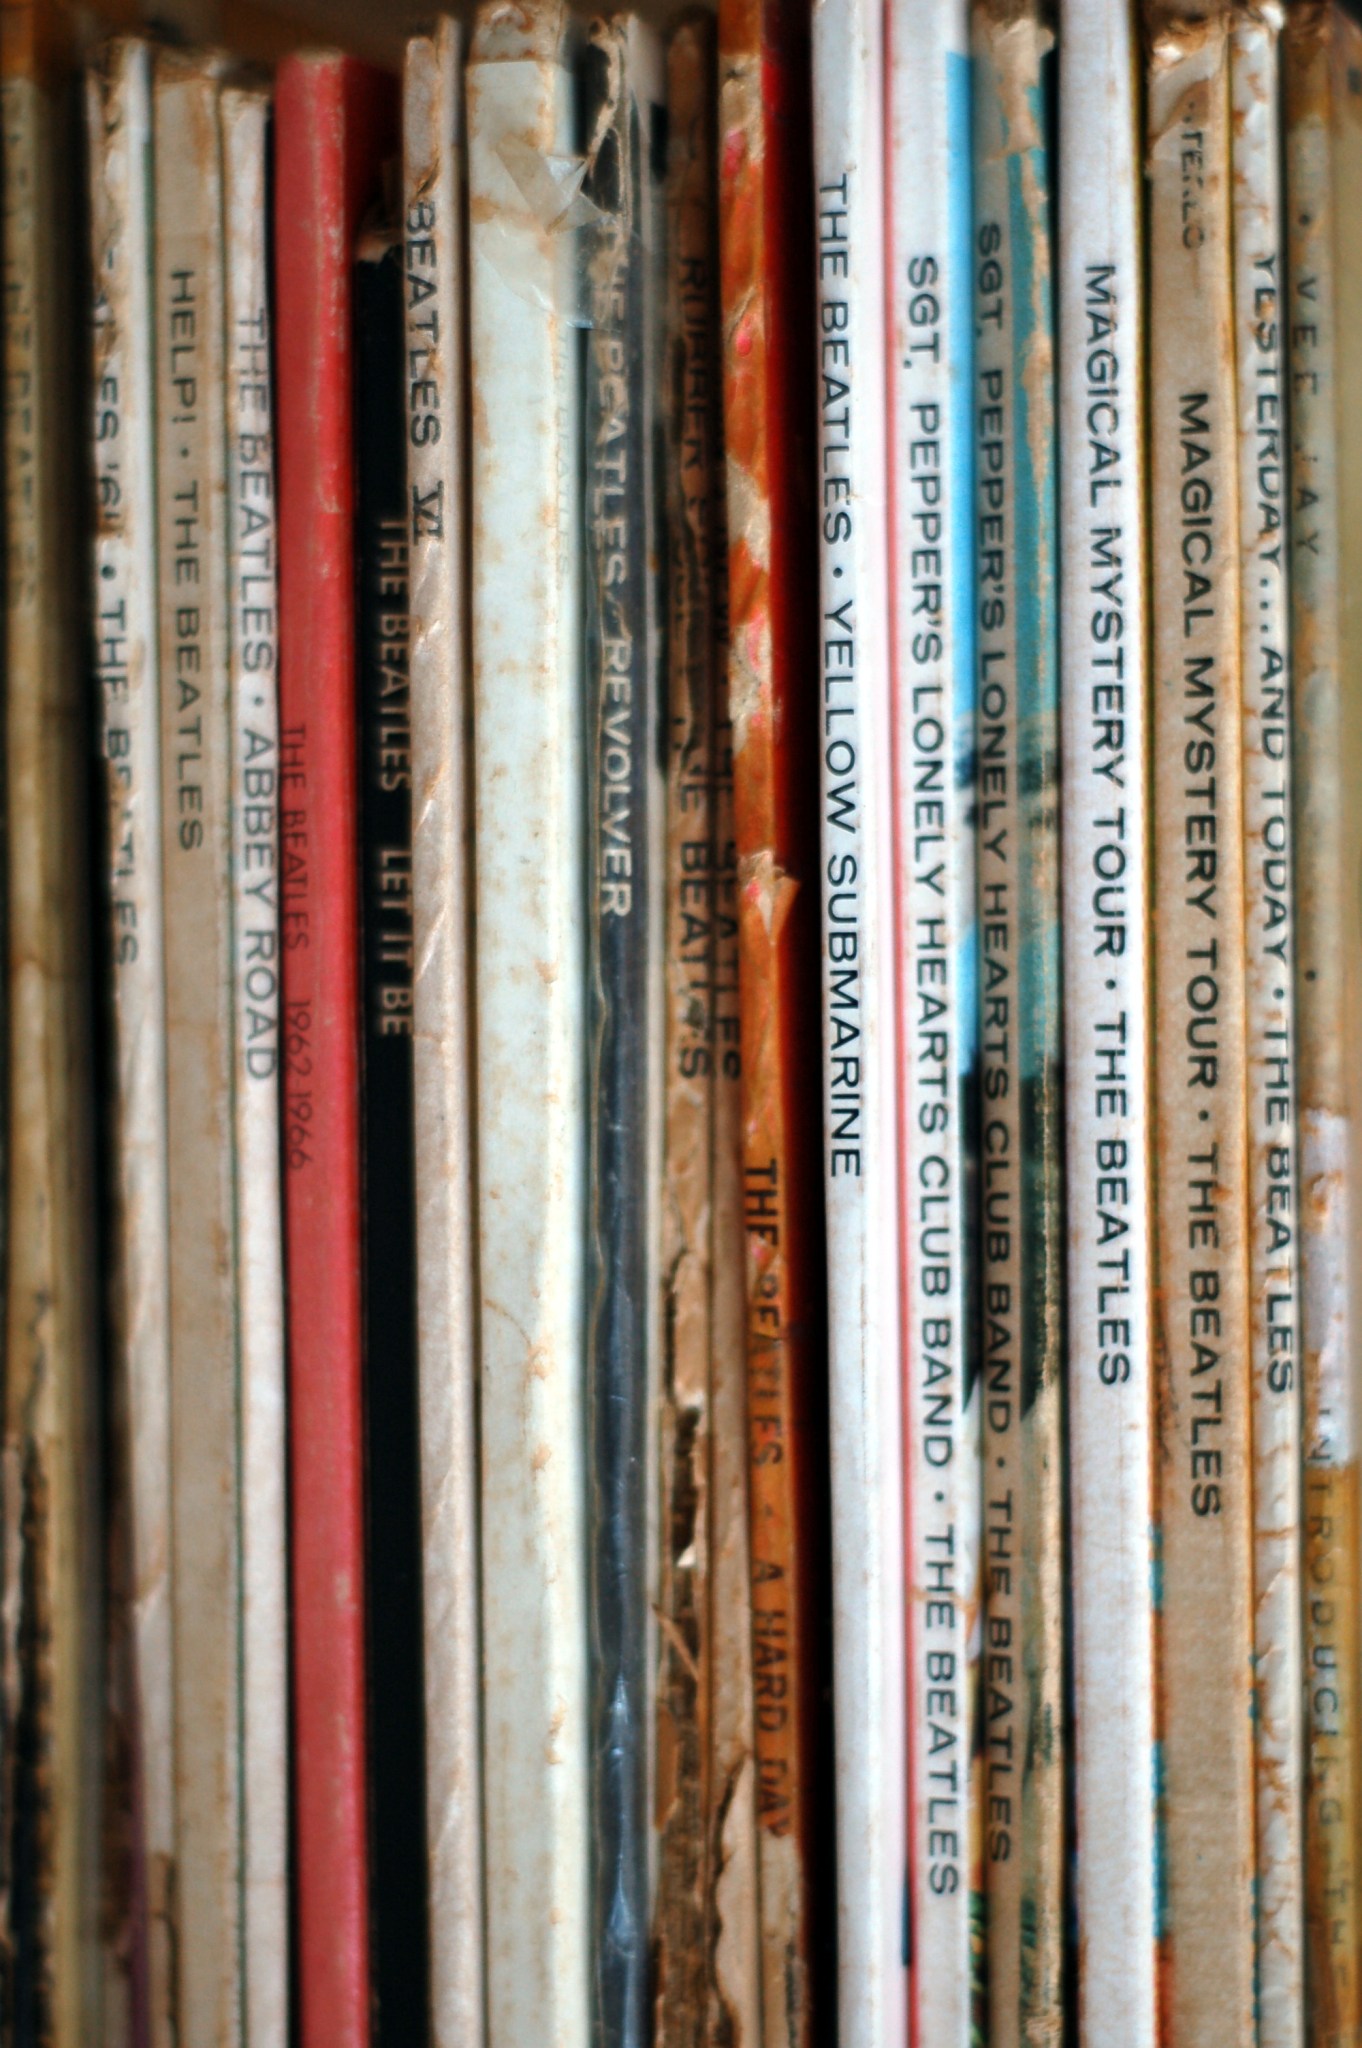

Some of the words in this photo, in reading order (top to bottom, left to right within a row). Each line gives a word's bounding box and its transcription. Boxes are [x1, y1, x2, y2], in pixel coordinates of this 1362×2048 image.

[818, 173, 849, 280] THE
[976, 223, 1004, 339] SGT.
[170, 270, 197, 424] HELP!
[238, 308, 266, 412] THE
[405, 199, 441, 448] BEATLES
[903, 257, 940, 369] SGT.
[1085, 265, 1121, 508] MAGICAL
[819, 301, 852, 545] BEATLES
[174, 481, 200, 585] THE
[239, 433, 274, 671] BEATLES
[378, 517, 410, 595] THE
[412, 480, 445, 546] VI
[909, 403, 945, 665] PEPPER'S
[978, 369, 1007, 632] PEPPER'S
[1179, 393, 1214, 637] MAGICAL
[176, 608, 204, 851] BEATLES
[378, 613, 412, 792] BEATLES
[822, 600, 856, 834] YELLOW
[1089, 528, 1125, 788] MYSTERY
[1260, 647, 1286, 760] AND
[243, 728, 275, 906] ABBEY
[281, 724, 307, 789] THE
[600, 637, 632, 915] REVOLVER
[912, 687, 947, 896] LONELY
[981, 652, 1009, 863] LONELY
[1183, 657, 1218, 919] MYSTERY
[282, 810, 309, 949] BEATLES
[380, 848, 412, 912] LET
[381, 932, 413, 968] IT
[1091, 808, 1126, 957] TOUR
[1262, 787, 1287, 968] TODAY
[245, 930, 276, 1081] ROAD
[380, 985, 414, 1036] BE
[827, 855, 861, 1177] SUBMARINE
[916, 918, 949, 1134] HEARTS
[983, 884, 1011, 1101] HEARTS
[1093, 1012, 1128, 1118] THE
[1185, 938, 1219, 1088] TOUR
[1263, 1018, 1290, 1126] THE
[919, 1155, 951, 1298] CLUB
[985, 1120, 1012, 1263] CLUB
[1095, 1139, 1130, 1385] BEATLES
[1187, 1143, 1220, 1249] THE
[922, 1318, 953, 1468] BAND
[986, 1283, 1012, 1434] BAND
[1189, 1270, 1222, 1516] BEATLES
[752, 1558, 788, 1585] A
[925, 1523, 957, 1629] THE
[988, 1490, 1014, 1596] THE
[753, 1609, 789, 1732] HARD
[987, 1615, 1015, 1863] BEATLES
[926, 1651, 960, 1896] BEATLES
